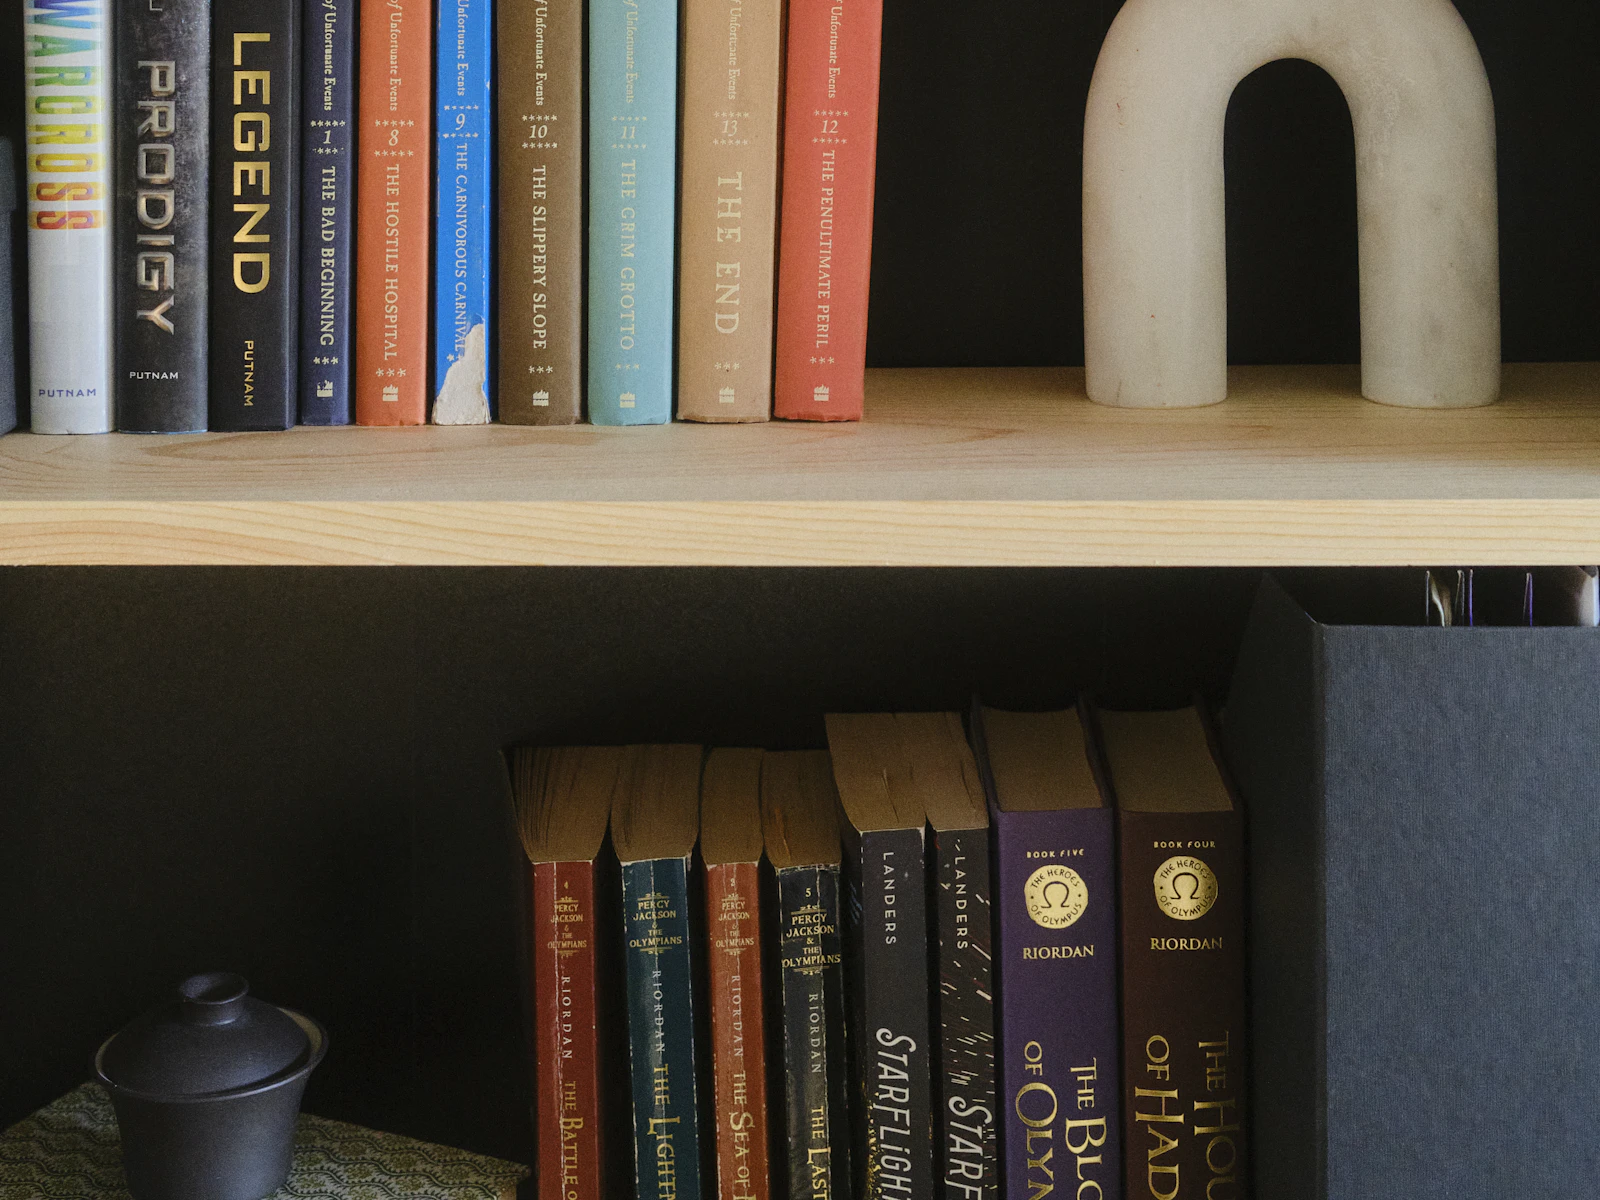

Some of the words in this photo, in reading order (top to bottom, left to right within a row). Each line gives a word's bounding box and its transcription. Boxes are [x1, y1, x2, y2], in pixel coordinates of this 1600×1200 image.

[324, 11, 337, 75] Unfortunate
[535, 6, 547, 70] Unfortunate
[829, 6, 842, 64] Unfortunate
[323, 77, 336, 111] Events
[535, 72, 547, 106] Events
[828, 67, 841, 99] Events
[323, 130, 332, 144] 1
[388, 129, 399, 146] 8
[455, 114, 466, 131] 9
[529, 125, 548, 139] 10
[721, 119, 738, 136] 13
[821, 120, 839, 134] 12
[233, 32, 271, 294] LEGEND
[456, 142, 468, 171] THE
[821, 150, 835, 182] THE
[321, 166, 336, 201] THE
[386, 164, 400, 196] THE
[532, 165, 547, 200] THE
[621, 159, 636, 198] THE
[136, 60, 176, 336] PRODIGY
[716, 171, 743, 243] THE
[321, 207, 336, 242] BAD
[386, 201, 399, 273] HOSTILE
[455, 174, 468, 279] CARNIVOROUS
[620, 207, 636, 257] GRIM
[532, 206, 547, 287] SLIPPERY
[817, 187, 834, 299] PENULTIMATE
[320, 247, 335, 346] BEGINNING
[620, 267, 635, 350] GROTTO
[714, 261, 741, 334] END
[384, 278, 399, 361] HOSPITAL
[454, 281, 467, 352] CARNIVAL
[532, 292, 547, 350] SLOPE
[816, 304, 830, 349] PERIL
[129, 370, 179, 380] PUTNAM
[243, 340, 255, 407] PUTNAM
[38, 388, 97, 398] PUTNAM
[1026, 851, 1056, 859] BOOK
[1060, 848, 1085, 858] FIVE
[1153, 841, 1183, 849] BOOK
[1030, 874, 1046, 889] THE
[1047, 868, 1080, 887] HEROES
[1160, 864, 1176, 880] THE
[1176, 860, 1210, 880] HEROES
[554, 904, 579, 912] PERCY
[633, 910, 676, 921] JACKSON
[638, 900, 670, 910] PERCY
[718, 911, 750, 921] JACKSON
[722, 901, 746, 910] PERCY
[883, 852, 897, 945] LANDERS
[954, 856, 968, 950] LANDERS
[1030, 904, 1041, 917] OF
[1042, 902, 1082, 925] OLYMPUS
[1160, 895, 1172, 908] OF
[1172, 894, 1212, 917] OLYMPUS
[550, 914, 583, 922] JACKSON
[786, 925, 835, 938] JACKSON
[792, 914, 827, 925] PERCY
[547, 940, 587, 949] OLYMPIANS
[629, 936, 682, 948] OLYMPIANS
[715, 938, 754, 947] OLYMPIANS
[1023, 945, 1094, 960] RIORDAN
[1150, 937, 1223, 950] RIORDAN
[783, 954, 841, 967] OLYMPIANS
[561, 976, 573, 1059] RIORDAN
[652, 970, 665, 1052] RIORDAN
[731, 975, 743, 1057] RIORDAN
[808, 993, 821, 1073] RIORDAN
[1024, 1040, 1043, 1076] OF
[1146, 1034, 1170, 1081] OF
[1198, 1030, 1229, 1092] THE
[564, 1081, 577, 1111] THE
[653, 1063, 670, 1105] THE
[733, 1070, 746, 1105] THE
[1070, 1057, 1097, 1110] THE
[811, 1106, 825, 1140] THE
[873, 1028, 917, 1200] STARFLIGH
[561, 1116, 584, 1185] BATTLE
[729, 1111, 755, 1158] SEA
[647, 1116, 680, 1200] LIGHT
[734, 1166, 750, 1189] OF
